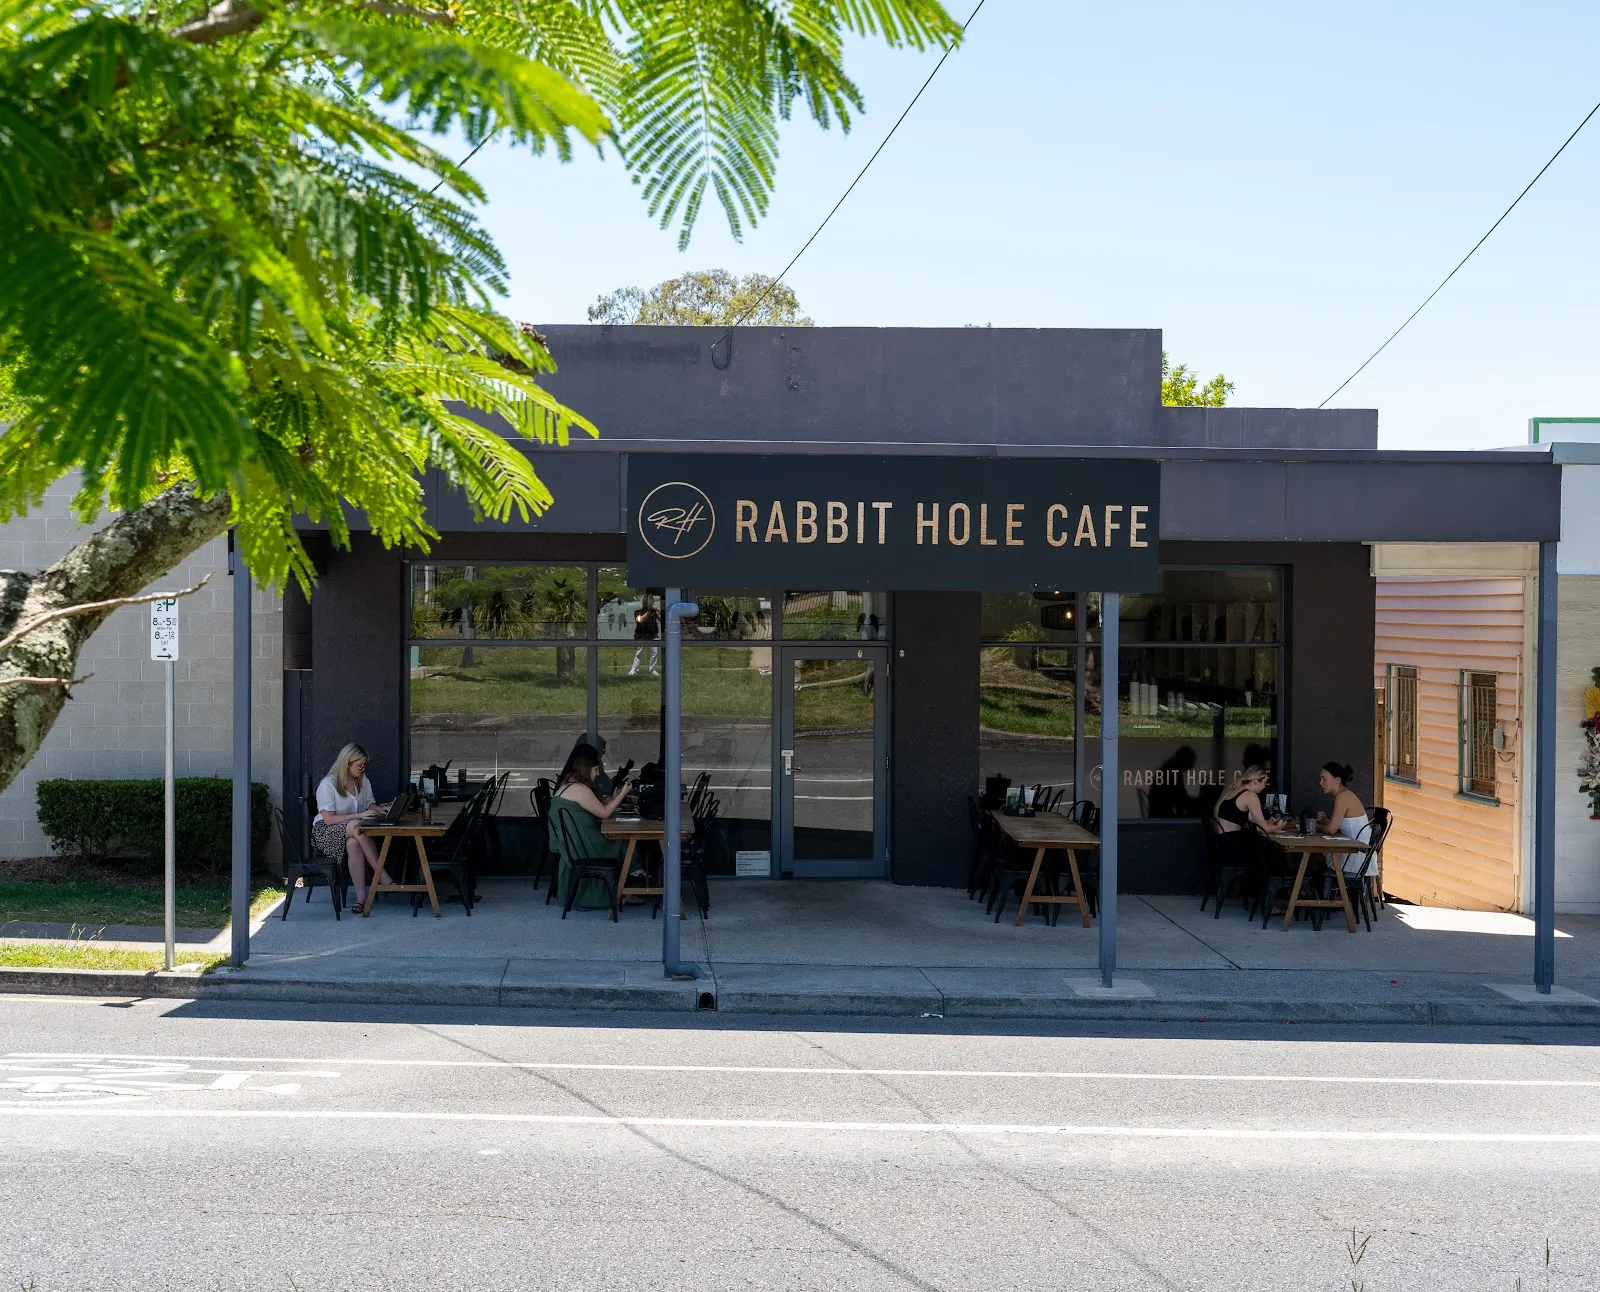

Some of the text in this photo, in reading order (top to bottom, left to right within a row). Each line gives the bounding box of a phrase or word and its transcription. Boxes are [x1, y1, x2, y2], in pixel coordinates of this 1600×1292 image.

[647, 502, 706, 545] RH
[735, 500, 1149, 548] RABBIT HOLE CAFE
[1123, 769, 1180, 786] RABBIT
[1187, 769, 1226, 786] HOLE
